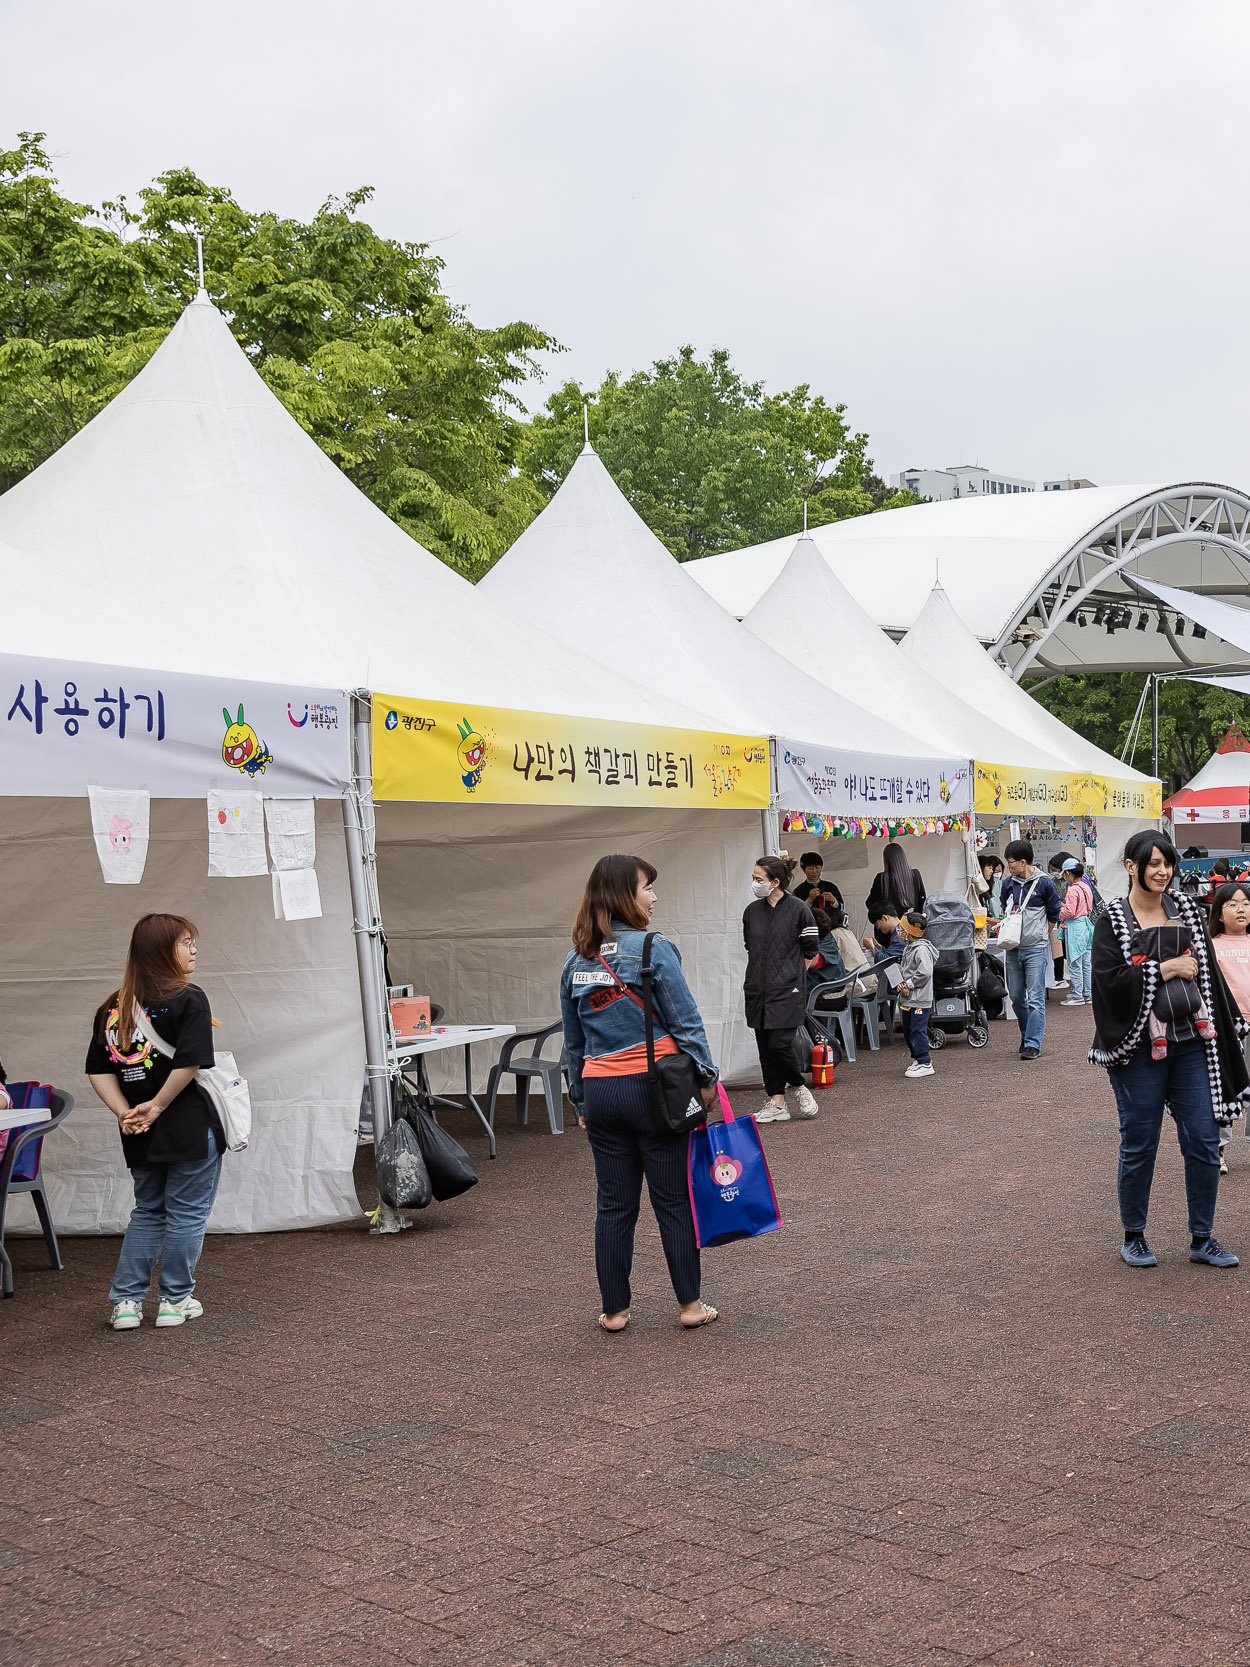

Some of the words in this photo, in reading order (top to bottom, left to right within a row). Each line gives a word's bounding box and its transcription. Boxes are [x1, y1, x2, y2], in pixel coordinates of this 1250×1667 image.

[7, 679, 166, 742] 사용하기
[311, 712, 338, 730] 행복광진
[401, 715, 437, 733] 광진구
[513, 740, 577, 783] 나만의
[584, 744, 639, 786] 책갈피
[647, 750, 694, 788] 만들기
[844, 773, 857, 801] 야!
[859, 775, 877, 802] 나도
[879, 776, 903, 804] 뜨개할
[905, 780, 914, 803] 수
[915, 777, 931, 804] 있다
[574, 973, 588, 982] FEEL
[600, 973, 612, 983] JOY
[685, 1105, 703, 1118] adidas
